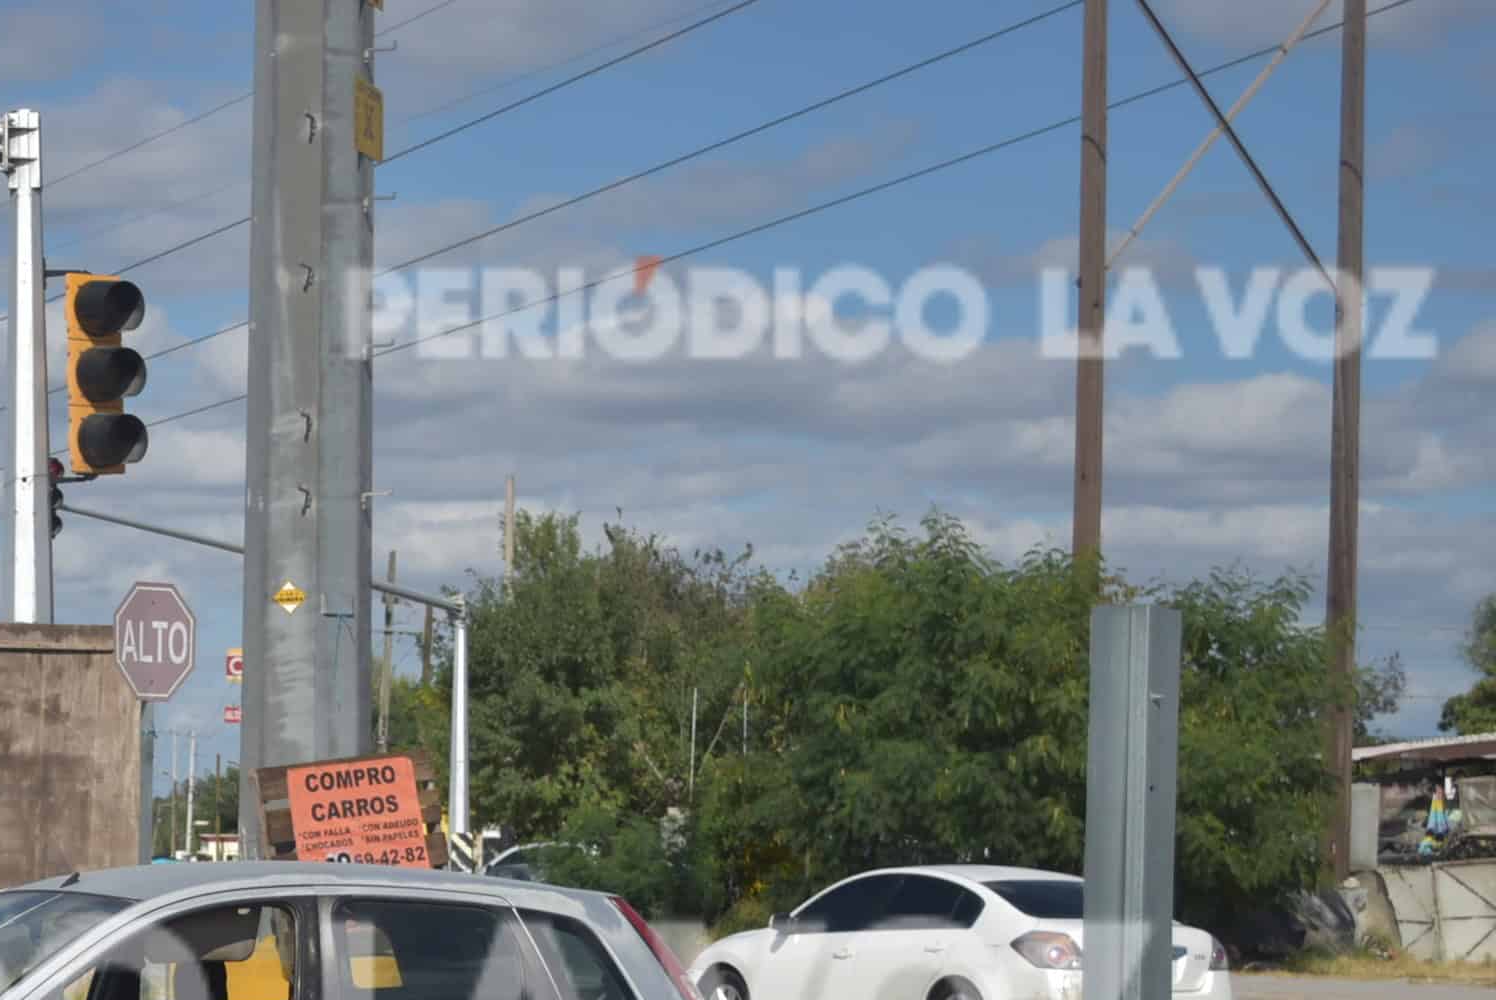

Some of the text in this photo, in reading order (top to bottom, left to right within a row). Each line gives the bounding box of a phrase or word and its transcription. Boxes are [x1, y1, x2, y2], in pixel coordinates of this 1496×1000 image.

[121, 619, 188, 665] ALTO
[304, 765, 396, 793] COMPRO
[311, 795, 399, 822] CARROS
